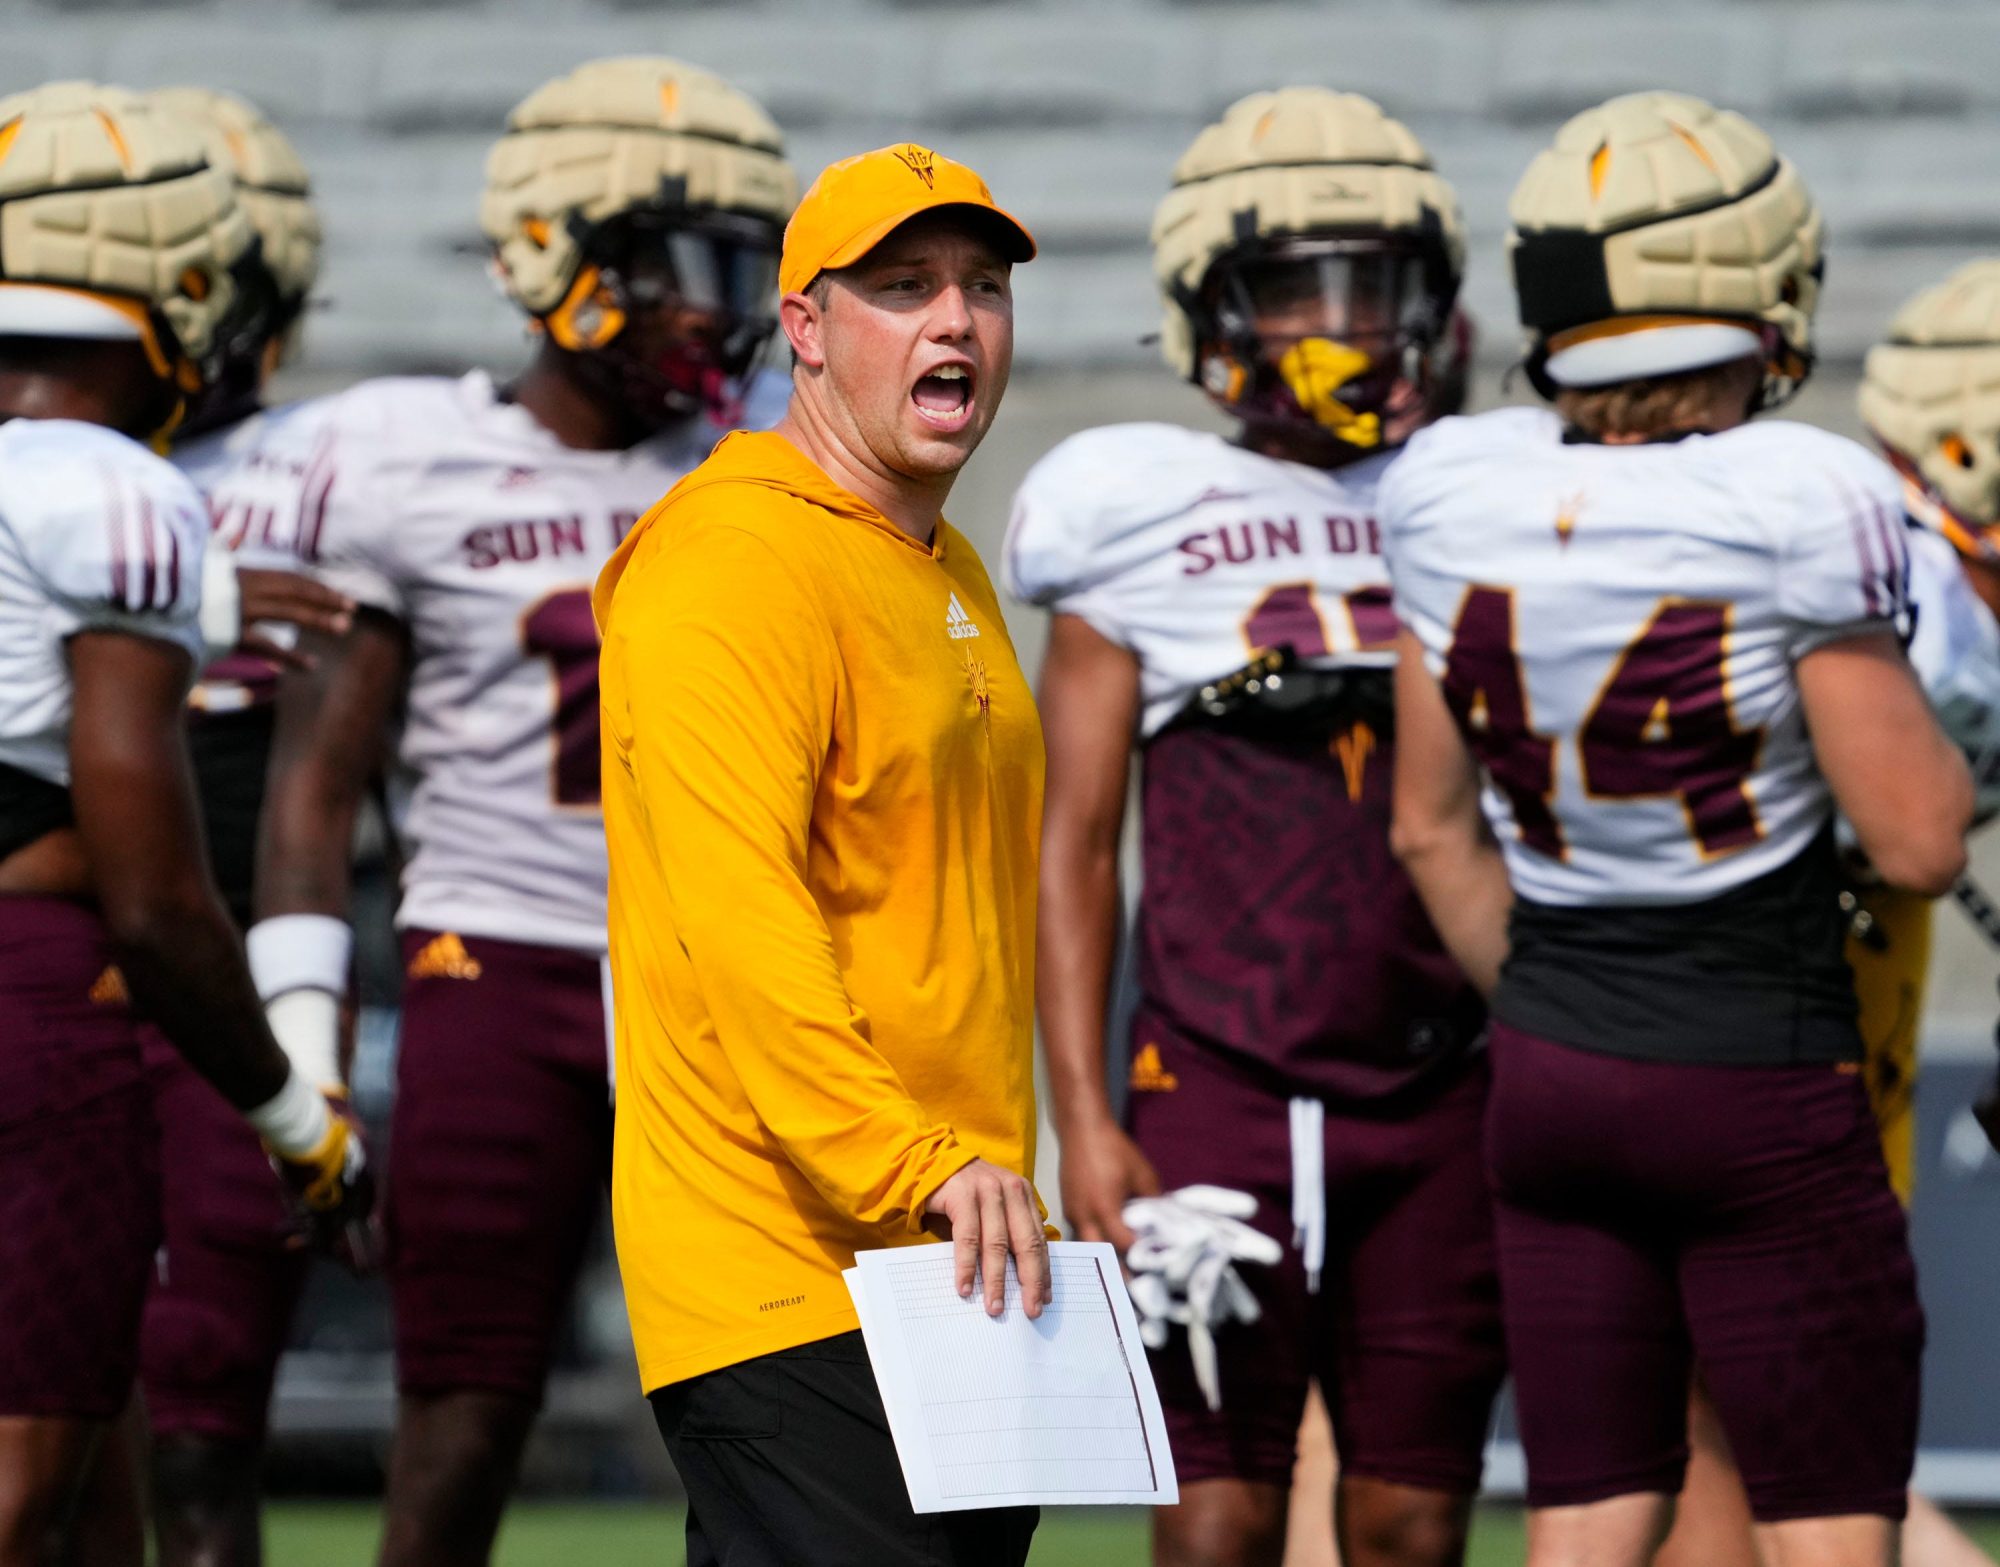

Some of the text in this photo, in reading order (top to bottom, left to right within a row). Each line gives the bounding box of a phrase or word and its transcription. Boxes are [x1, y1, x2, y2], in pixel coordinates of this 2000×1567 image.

[462, 512, 586, 571] SUN
[1177, 513, 1301, 576] SUN
[946, 620, 980, 639] adidas
[1443, 582, 1768, 865] 44
[759, 1295, 806, 1312] AEROREADY
